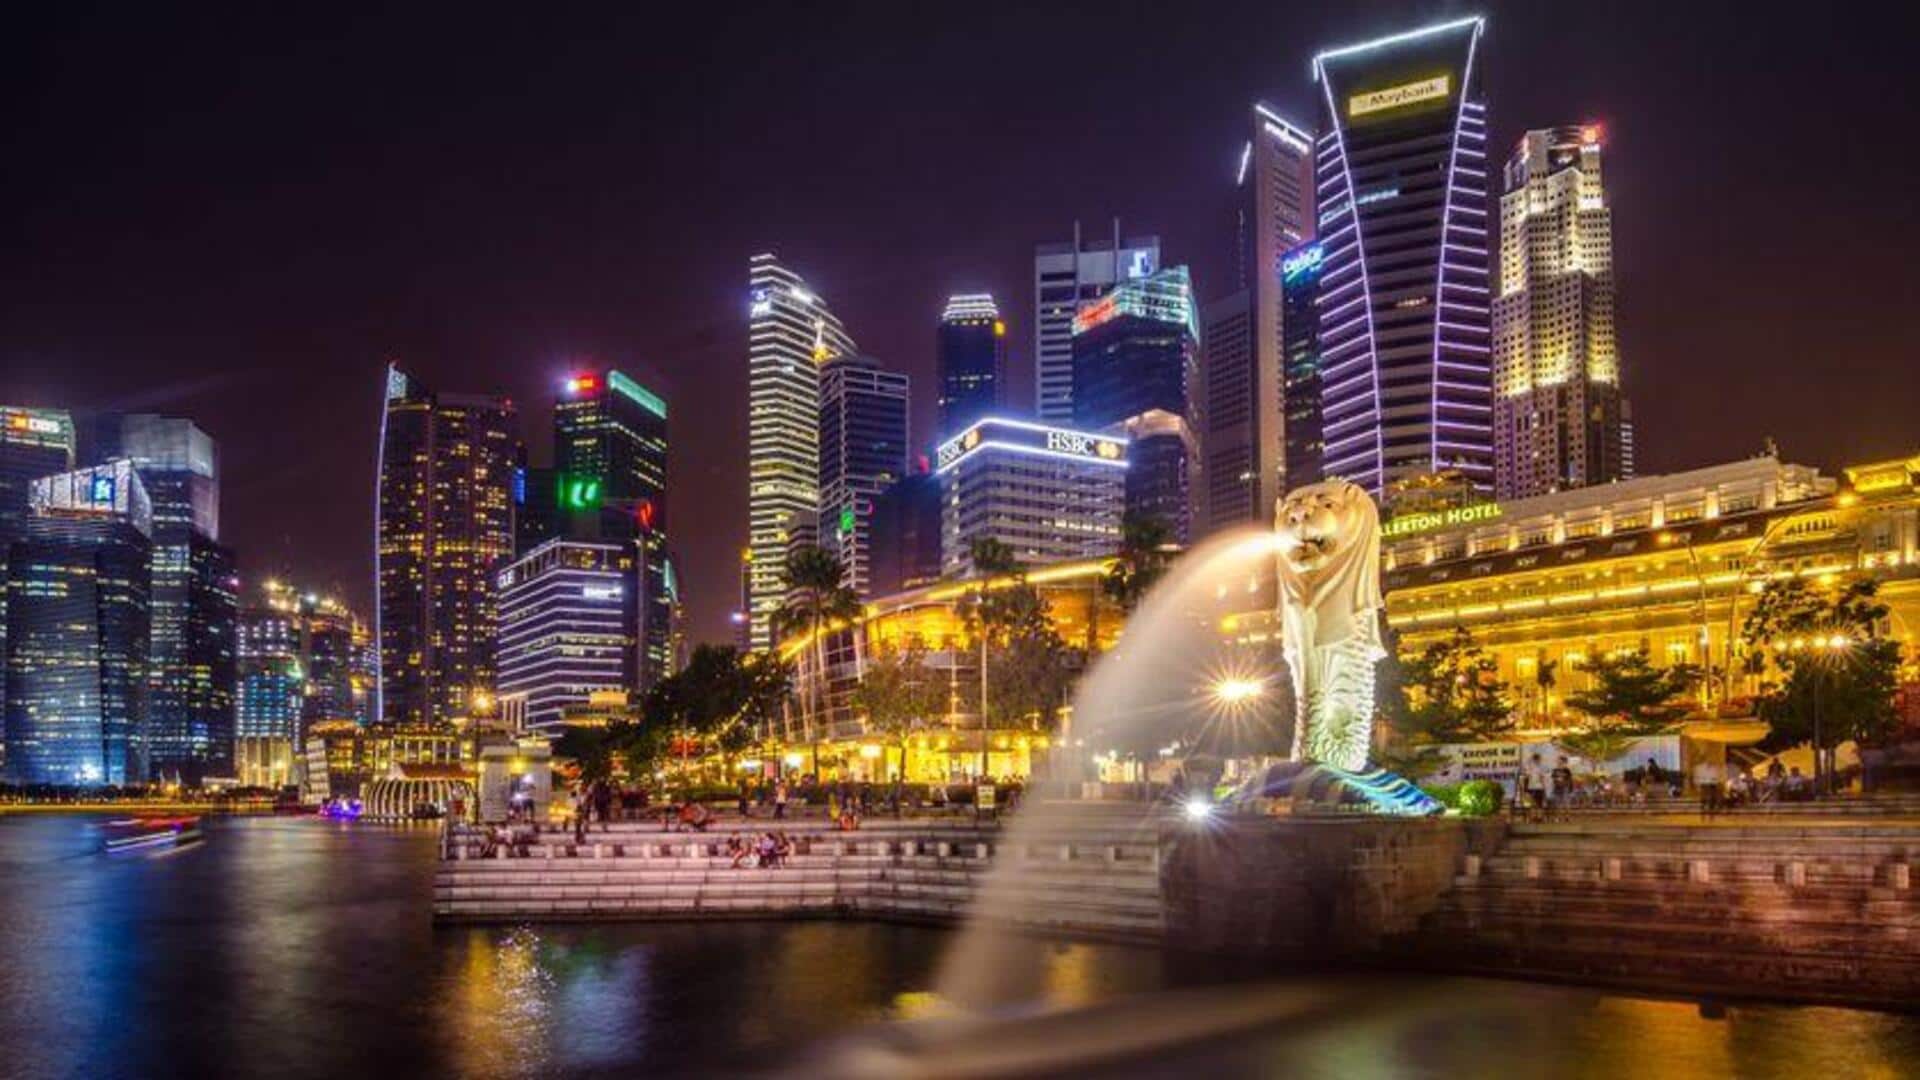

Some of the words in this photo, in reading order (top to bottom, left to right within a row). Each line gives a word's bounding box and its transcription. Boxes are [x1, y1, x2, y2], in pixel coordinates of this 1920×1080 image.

[1370, 83, 1434, 105] Maybank
[1047, 431, 1094, 457] HSBC
[1447, 503, 1503, 524] HOTEL
